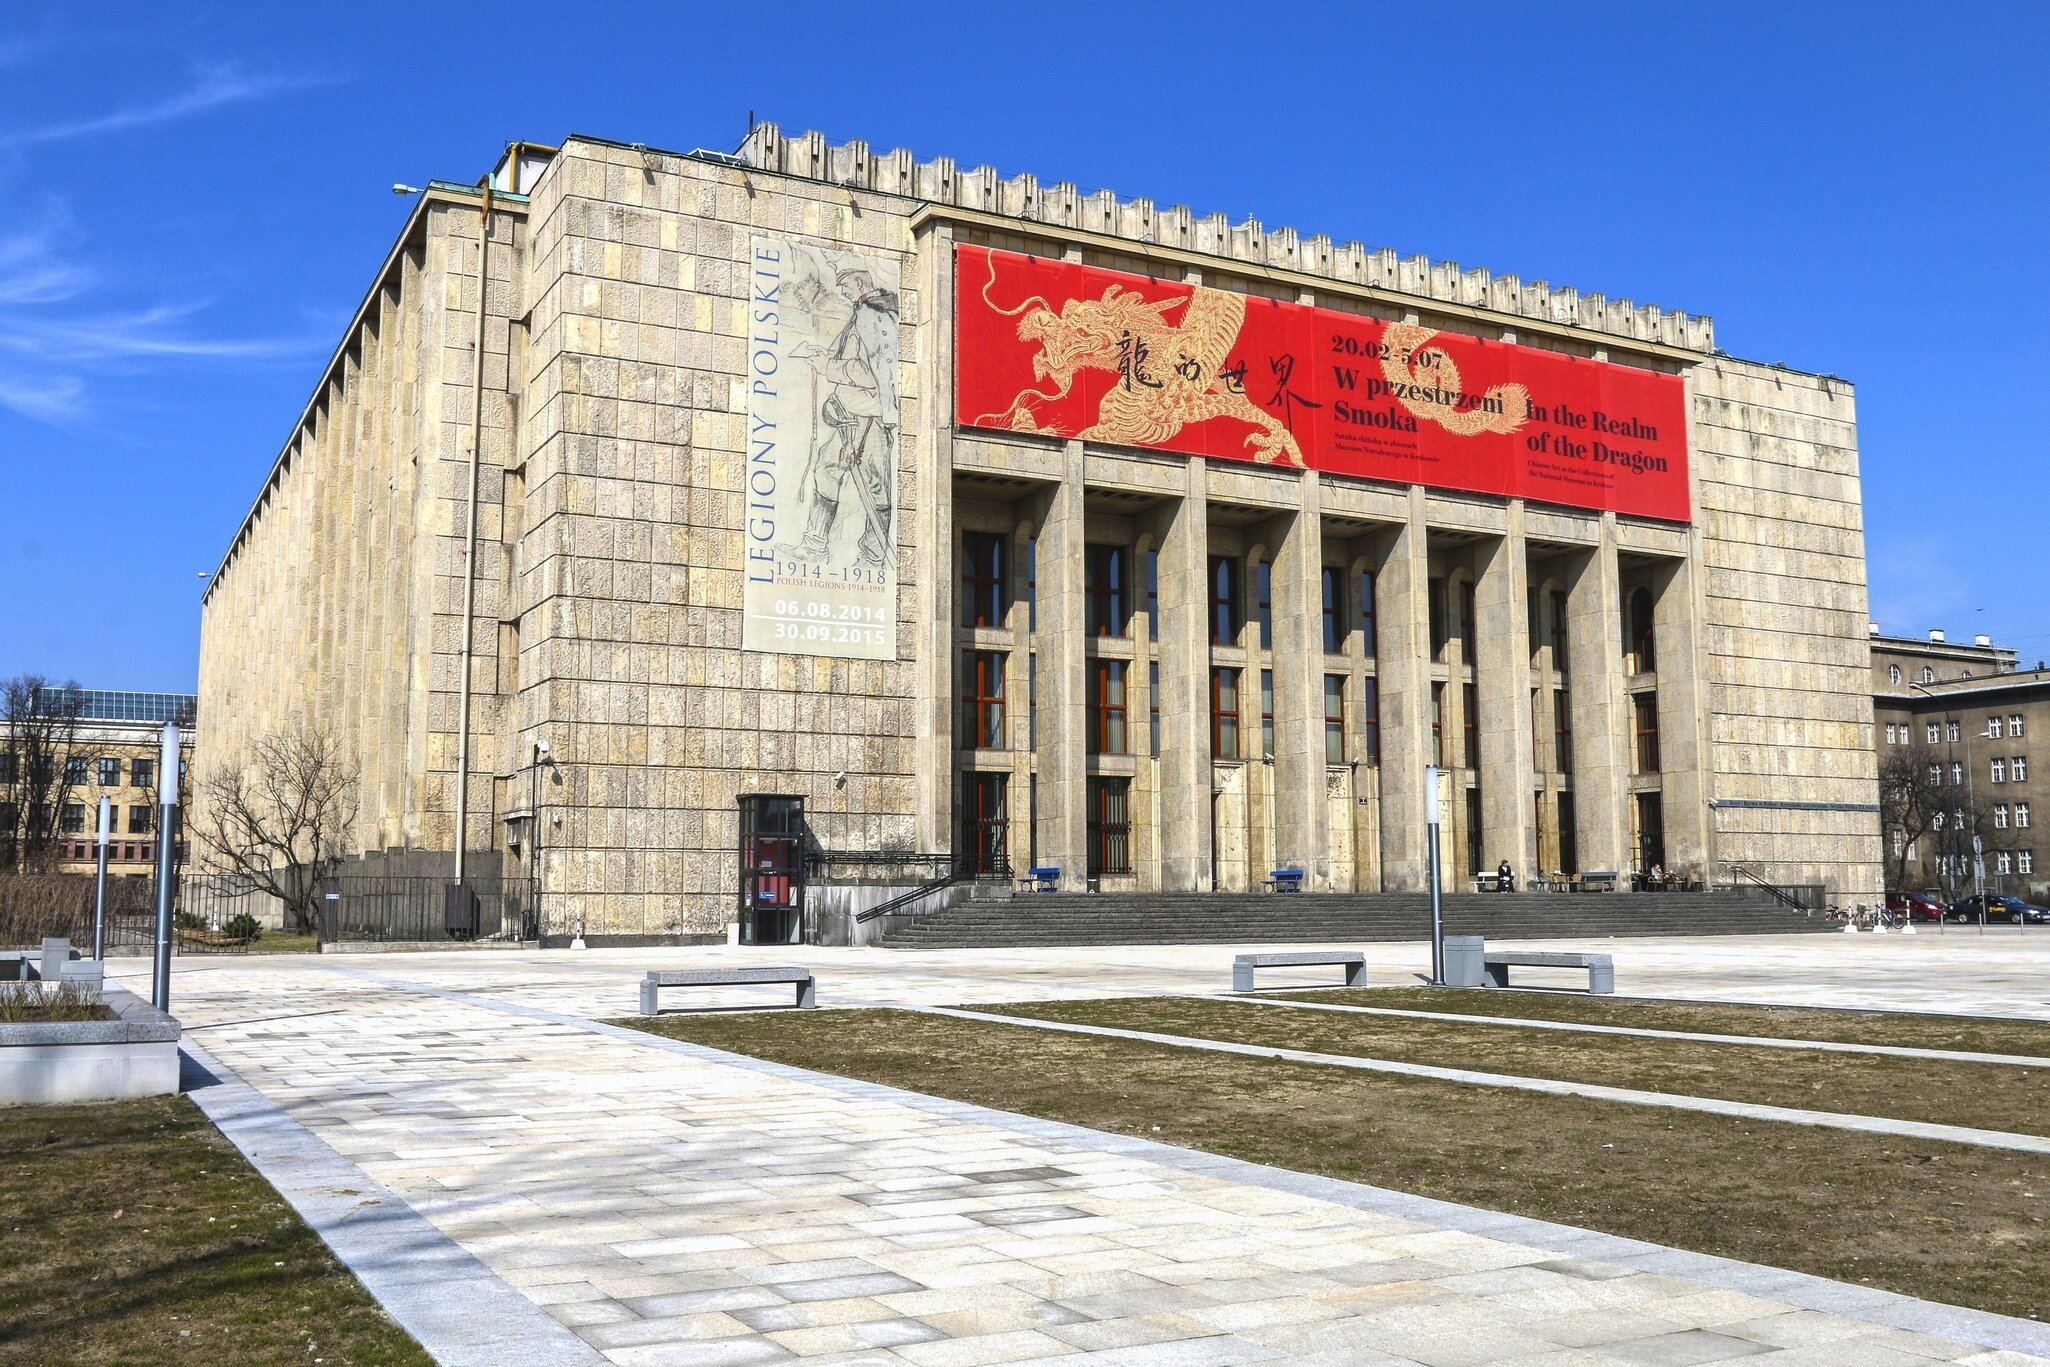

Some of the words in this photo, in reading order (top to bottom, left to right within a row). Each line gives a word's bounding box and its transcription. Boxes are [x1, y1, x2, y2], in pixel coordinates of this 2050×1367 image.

[752, 247, 781, 398] POLSKIE
[1332, 365, 1361, 391] W
[1366, 376, 1504, 414] przestrzeni
[1334, 400, 1418, 433] Smoka
[1525, 399, 1548, 422] In
[1553, 403, 1588, 429] the
[1592, 410, 1658, 442] Realm
[1526, 432, 1551, 453] of
[1553, 435, 1588, 460] the
[1592, 441, 1668, 475] Dragon
[750, 412, 777, 584] LEGIONY
[776, 577, 807, 587] POLISH
[809, 580, 846, 590] LEGIONS
[775, 599, 886, 623] 06.08.2014
[774, 623, 886, 645] 30.09.2015
